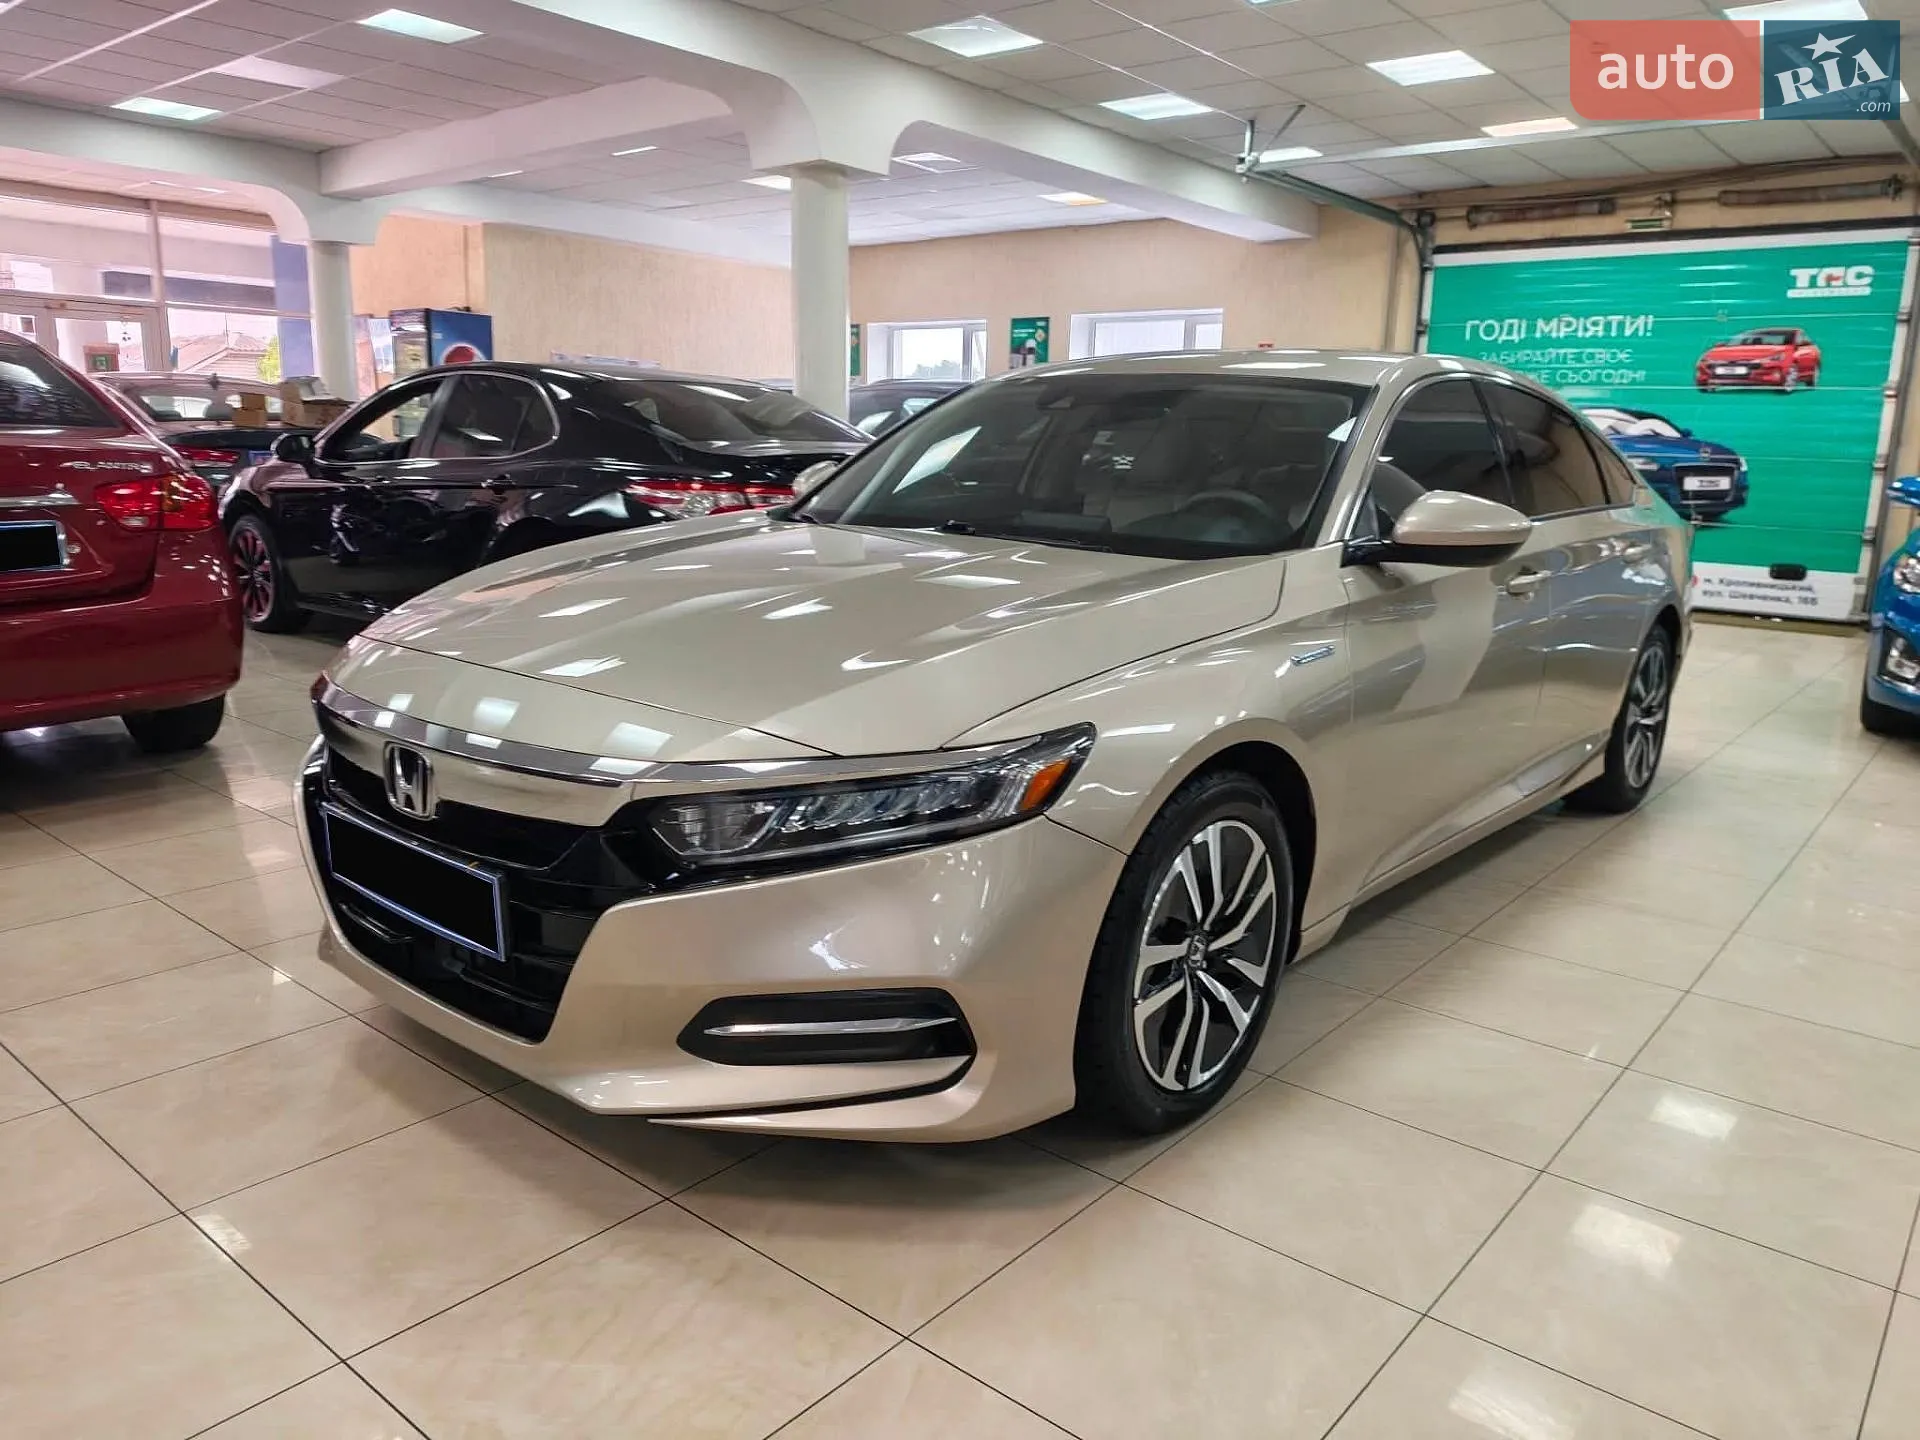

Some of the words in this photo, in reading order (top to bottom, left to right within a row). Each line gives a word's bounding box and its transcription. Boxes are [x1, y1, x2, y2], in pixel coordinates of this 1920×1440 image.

[1465, 318, 1527, 344] ГОДІ
[1535, 314, 1654, 338] МРІЯТИ!
[1479, 349, 1577, 365] ЗАБИРАЙТЕ
[1583, 348, 1634, 363] СВОЄ
